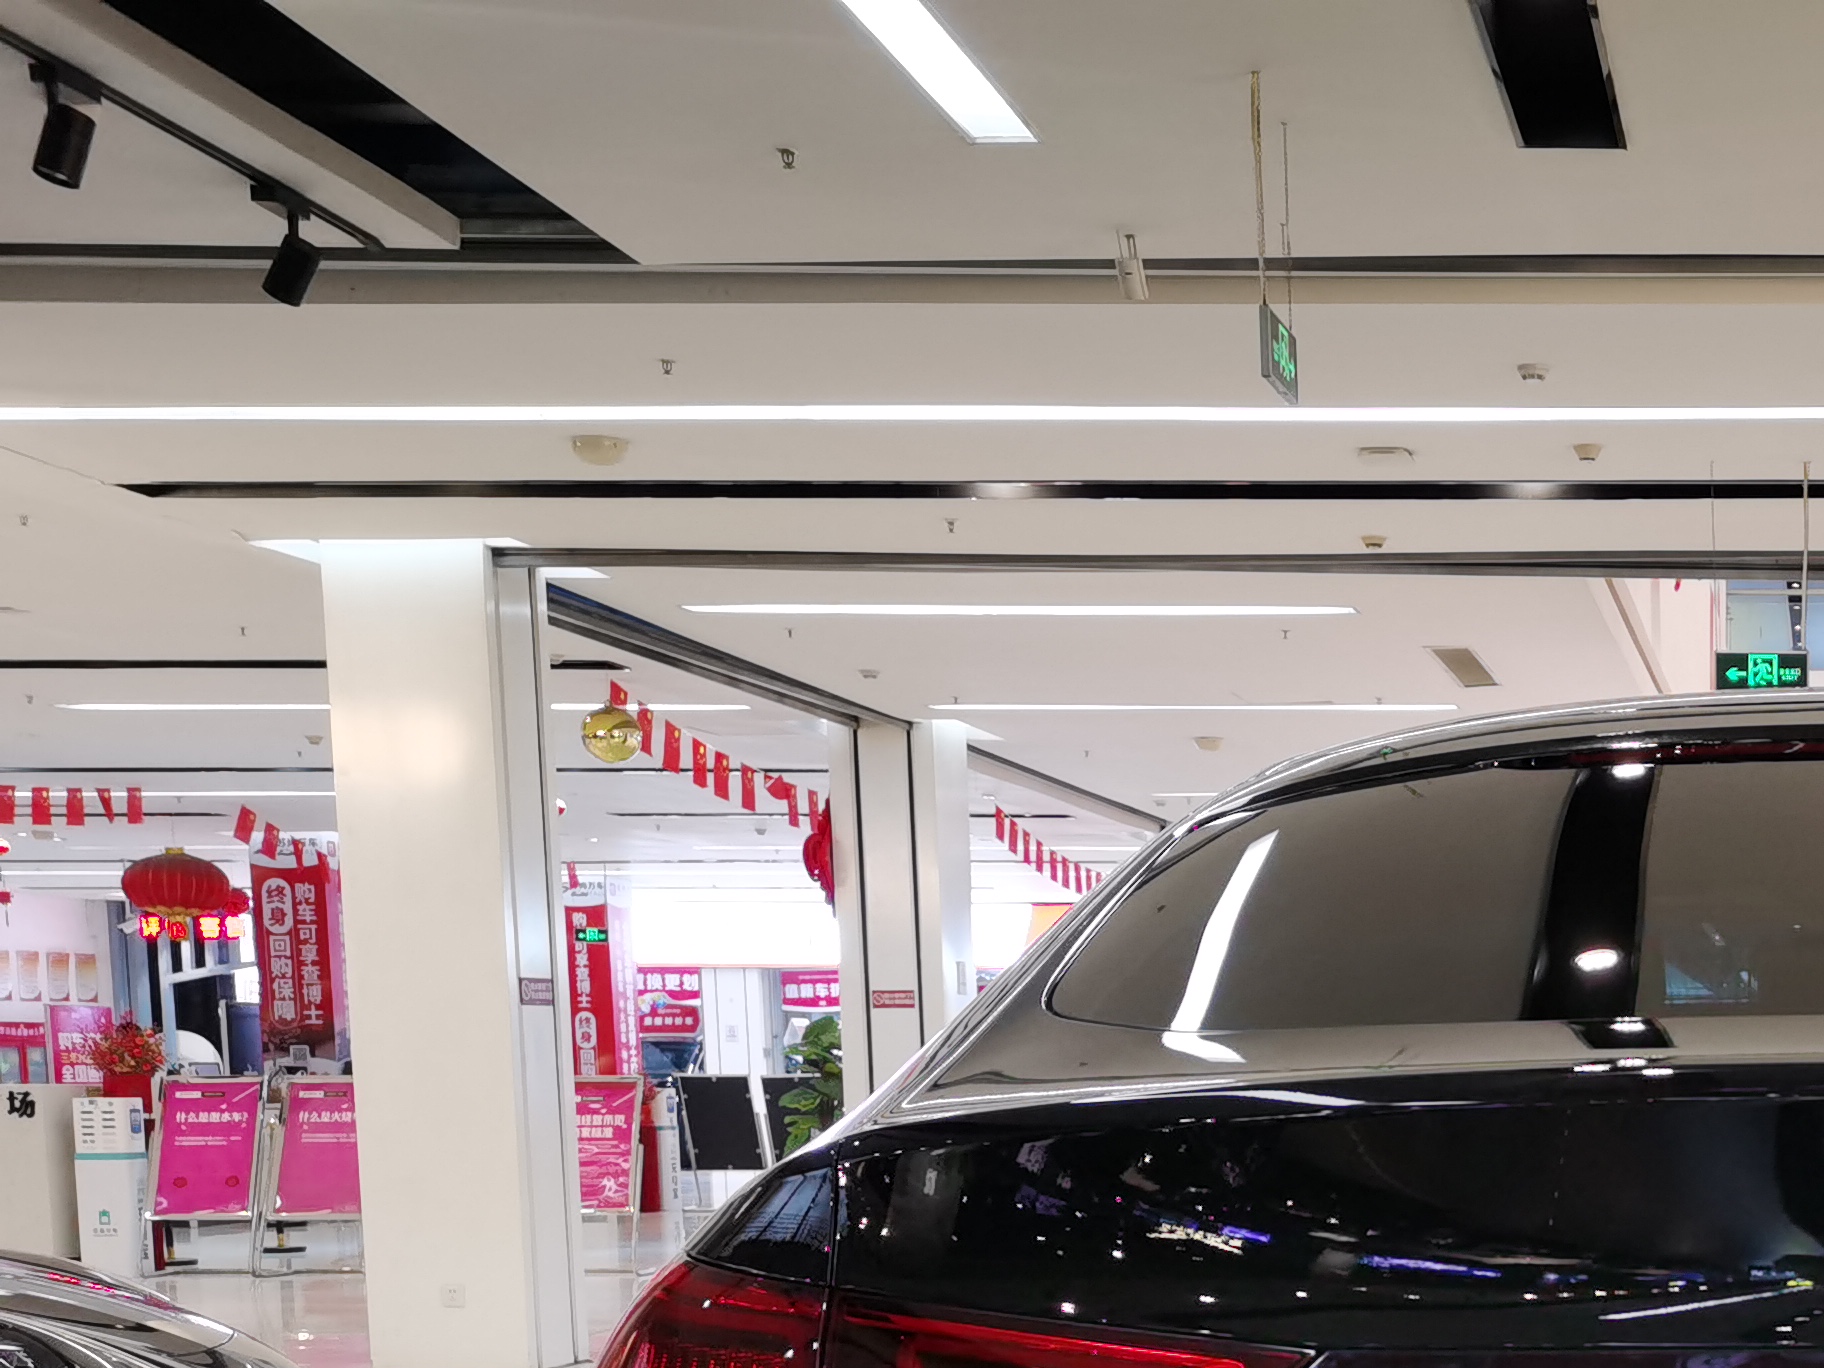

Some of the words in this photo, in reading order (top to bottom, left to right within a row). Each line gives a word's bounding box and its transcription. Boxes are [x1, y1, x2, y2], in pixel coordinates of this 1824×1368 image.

[265, 884, 296, 1021] 终身回购保障
[295, 882, 324, 1025] 购车可享查博士
[6, 1090, 36, 1119] 场
[299, 1110, 356, 1123] 什么是火烧
